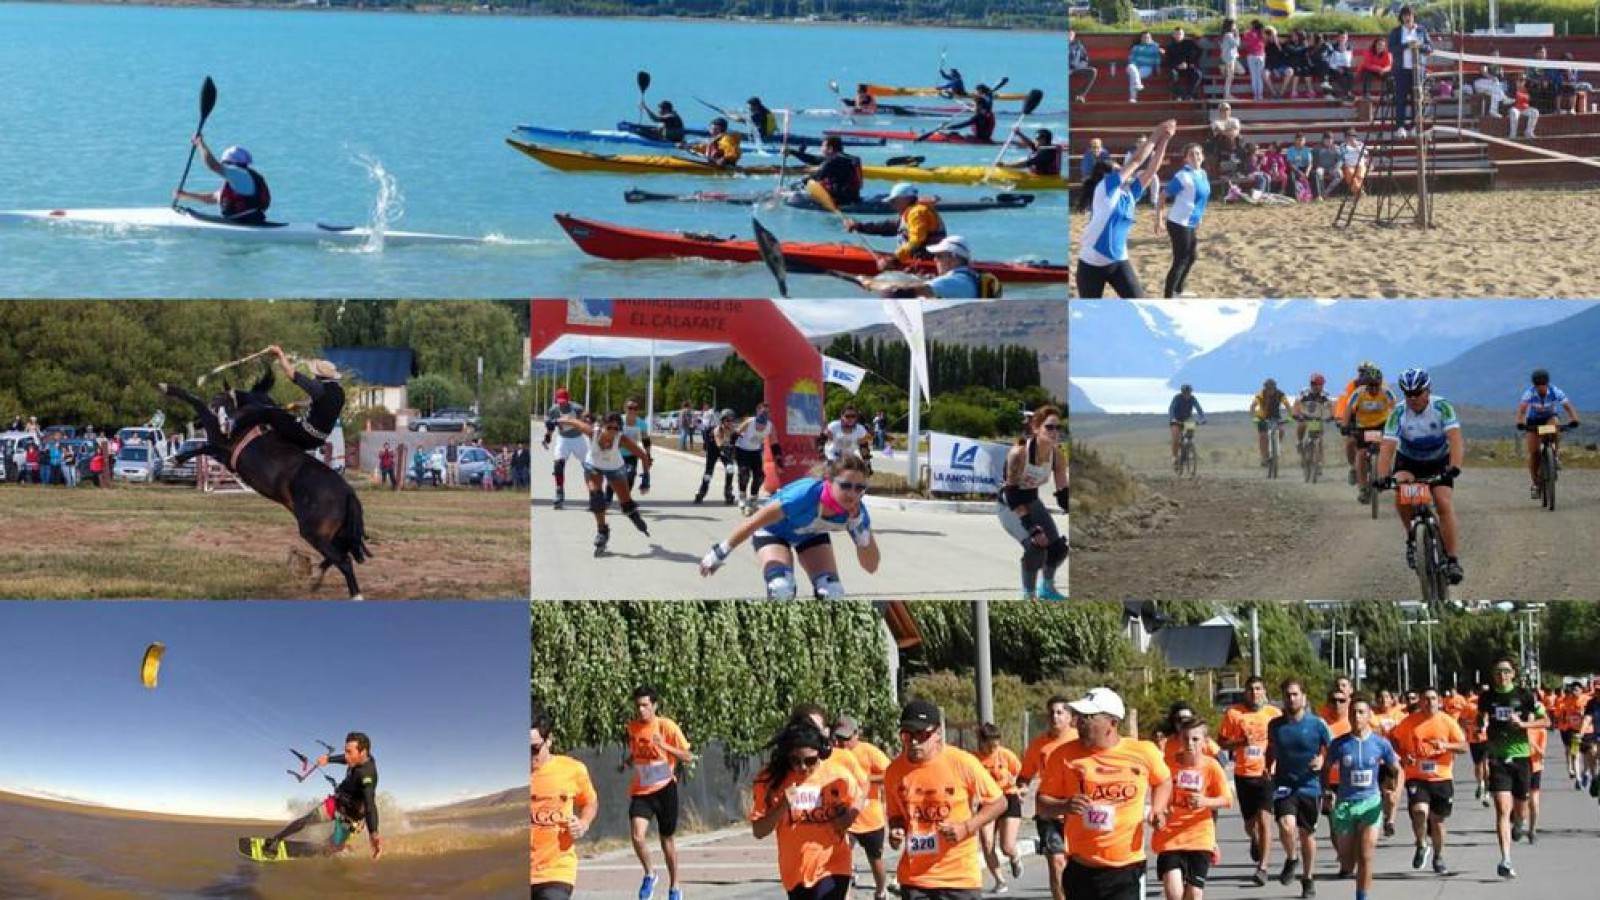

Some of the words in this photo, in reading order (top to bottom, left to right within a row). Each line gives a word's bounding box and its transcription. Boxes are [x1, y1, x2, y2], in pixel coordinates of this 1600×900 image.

[630, 312, 648, 326] EL
[652, 314, 729, 332] CALAFATE
[1087, 808, 1108, 824] 122
[911, 837, 935, 851] 320
